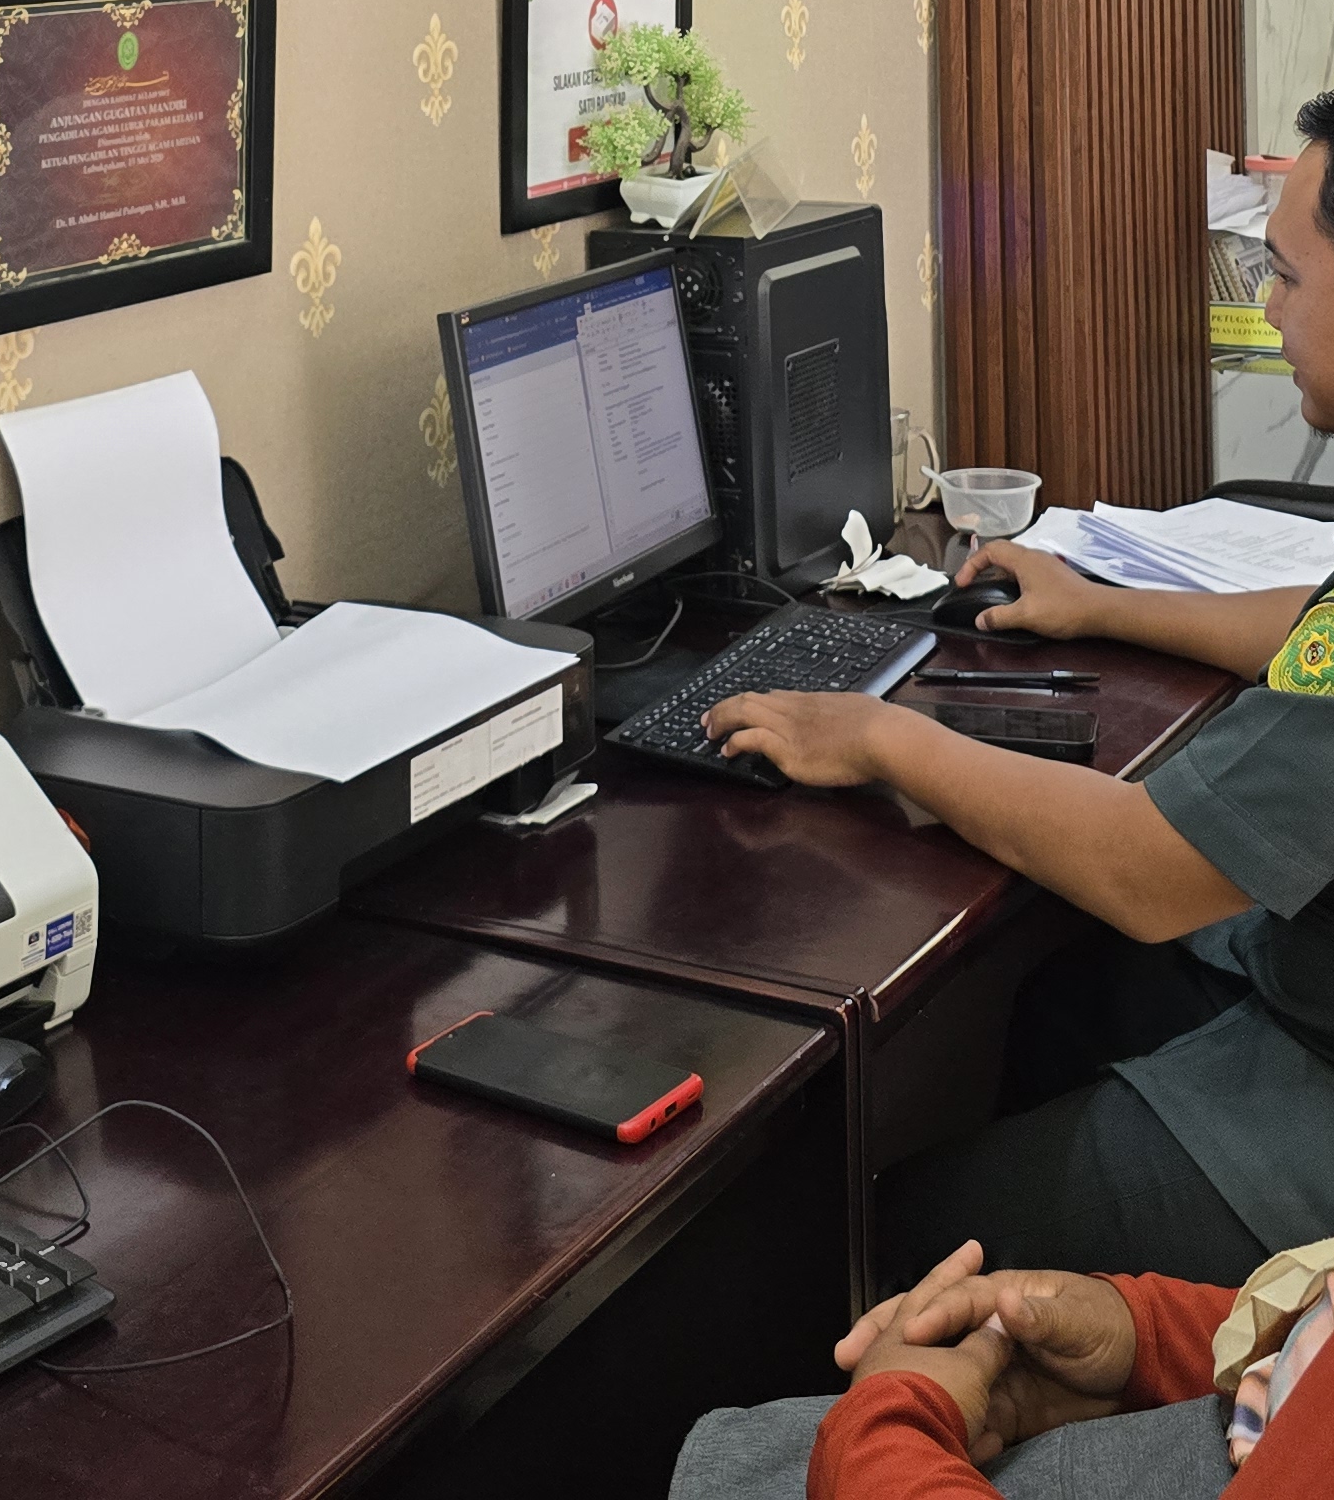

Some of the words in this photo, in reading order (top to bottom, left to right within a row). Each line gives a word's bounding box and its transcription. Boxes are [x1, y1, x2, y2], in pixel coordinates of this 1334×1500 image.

[50, 111, 102, 129] ANJUNGAN
[104, 105, 147, 120] GUGATAN
[42, 157, 68, 167] KETUA
